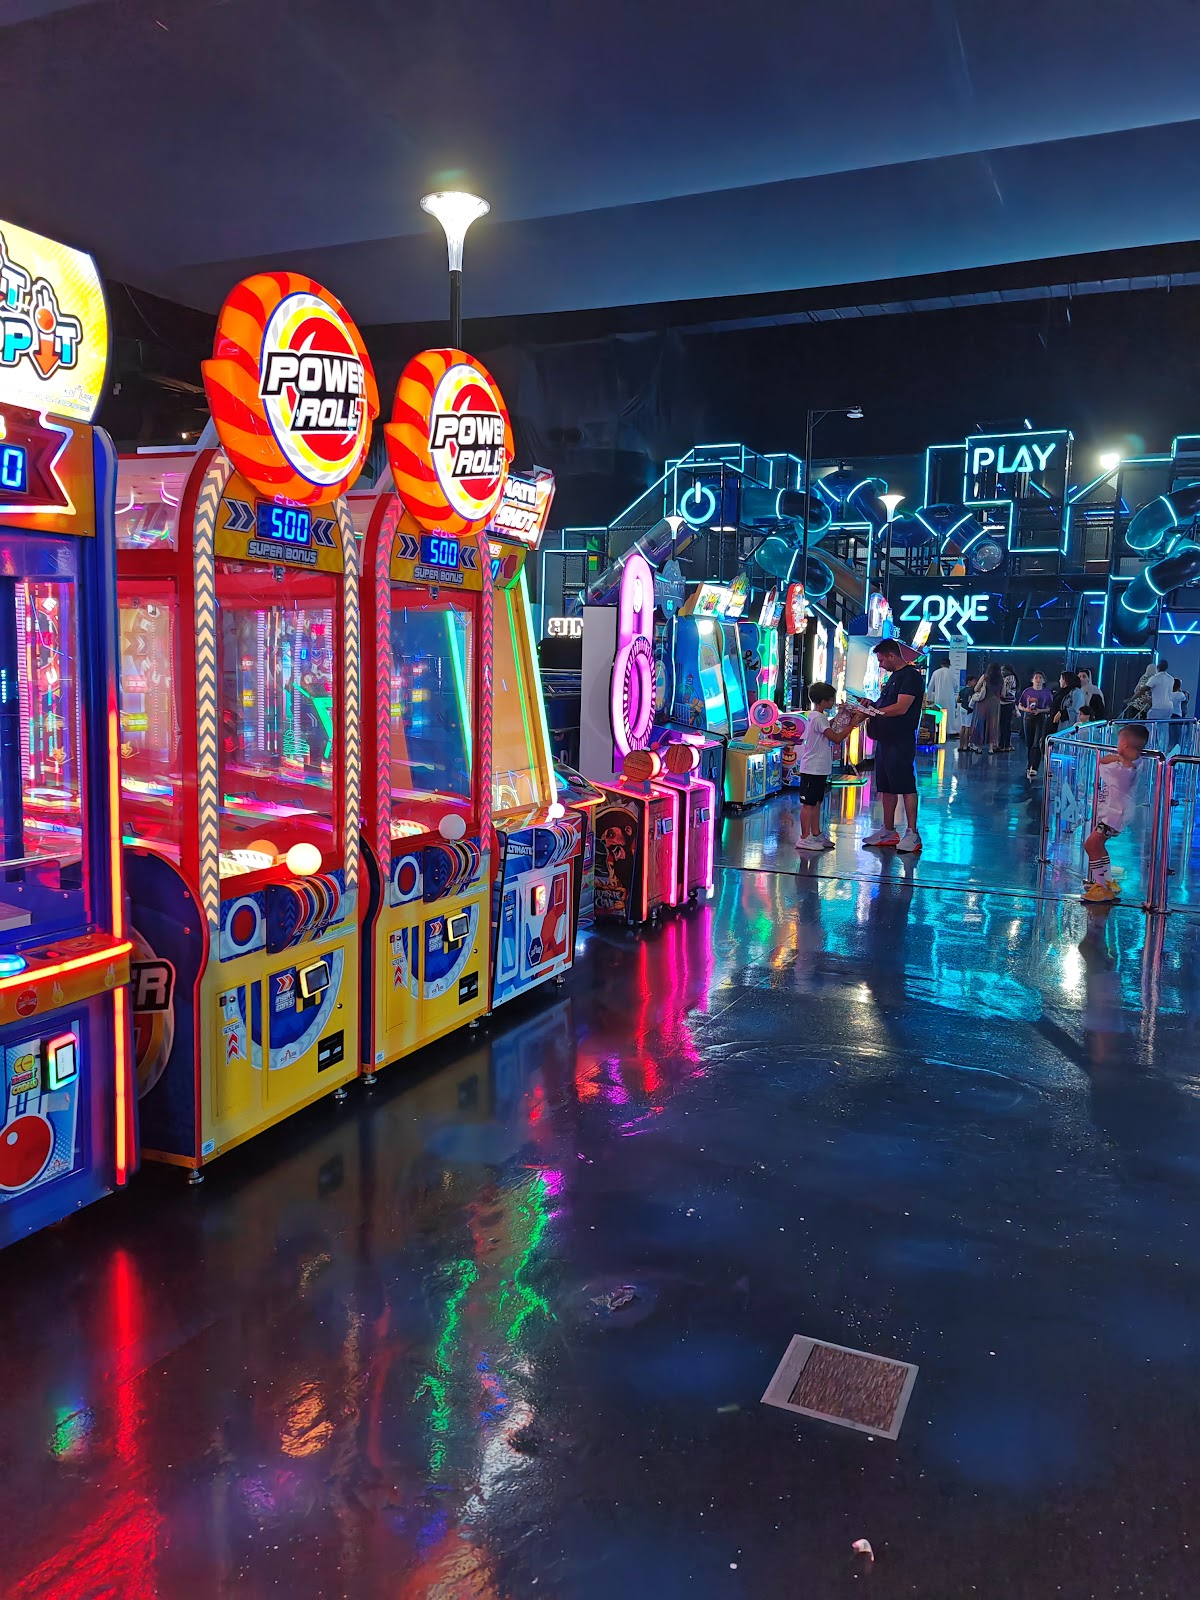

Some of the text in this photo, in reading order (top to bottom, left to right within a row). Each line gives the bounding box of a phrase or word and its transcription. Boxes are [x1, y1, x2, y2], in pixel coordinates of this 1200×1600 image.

[973, 442, 1056, 475] PLAY
[271, 508, 309, 543] 500
[497, 504, 540, 533] SHOT
[248, 540, 318, 565] SUPER BONUS
[430, 537, 459, 567] 500
[414, 565, 464, 584] SUPER BONUS
[900, 594, 990, 622] ZONE
